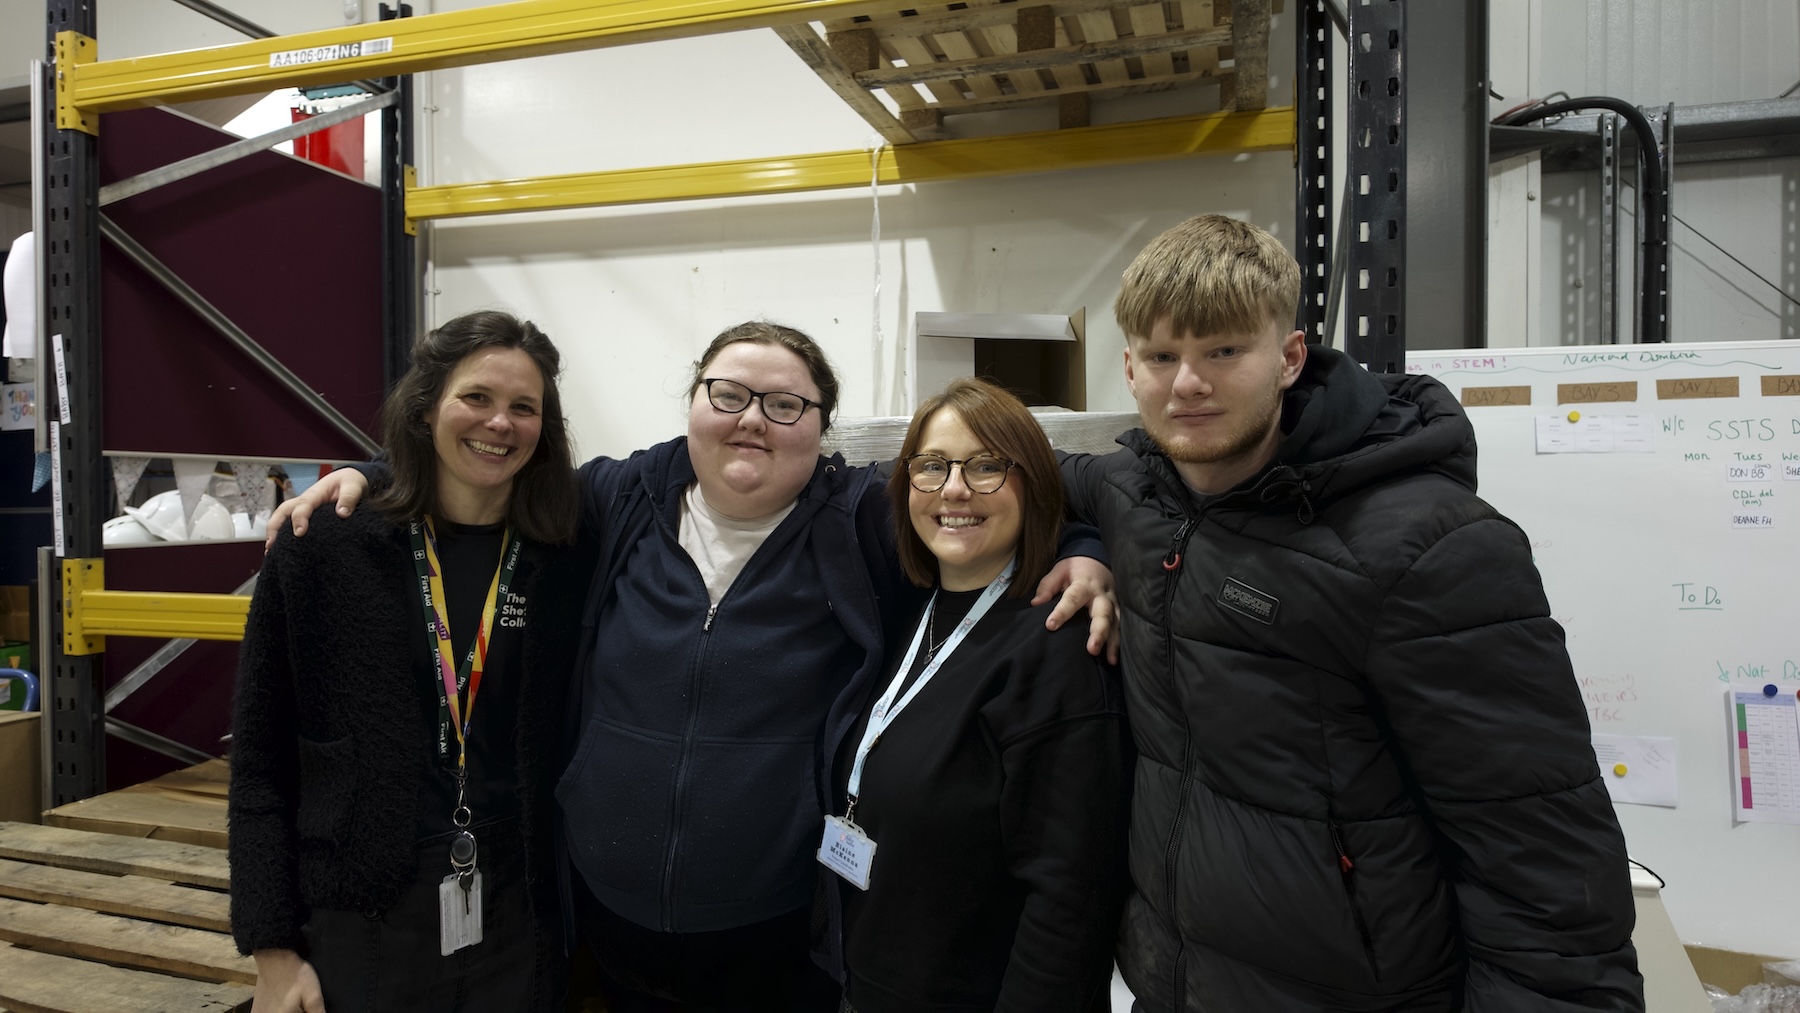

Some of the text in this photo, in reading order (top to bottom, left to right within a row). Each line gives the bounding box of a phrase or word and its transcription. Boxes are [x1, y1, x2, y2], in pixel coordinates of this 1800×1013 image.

[1431, 360, 1442, 369] in
[1571, 385, 1620, 401] BAY 3
[1671, 379, 1723, 397] BAY 4
[1466, 388, 1516, 405] BAY 2
[1662, 415, 1685, 436] W/C
[1706, 418, 1775, 441] SSTS
[1733, 452, 1763, 461] Tues
[1781, 452, 1800, 461] We
[505, 592, 526, 605] The
[1671, 583, 1722, 605] To Do
[1737, 663, 1770, 679] Nat
